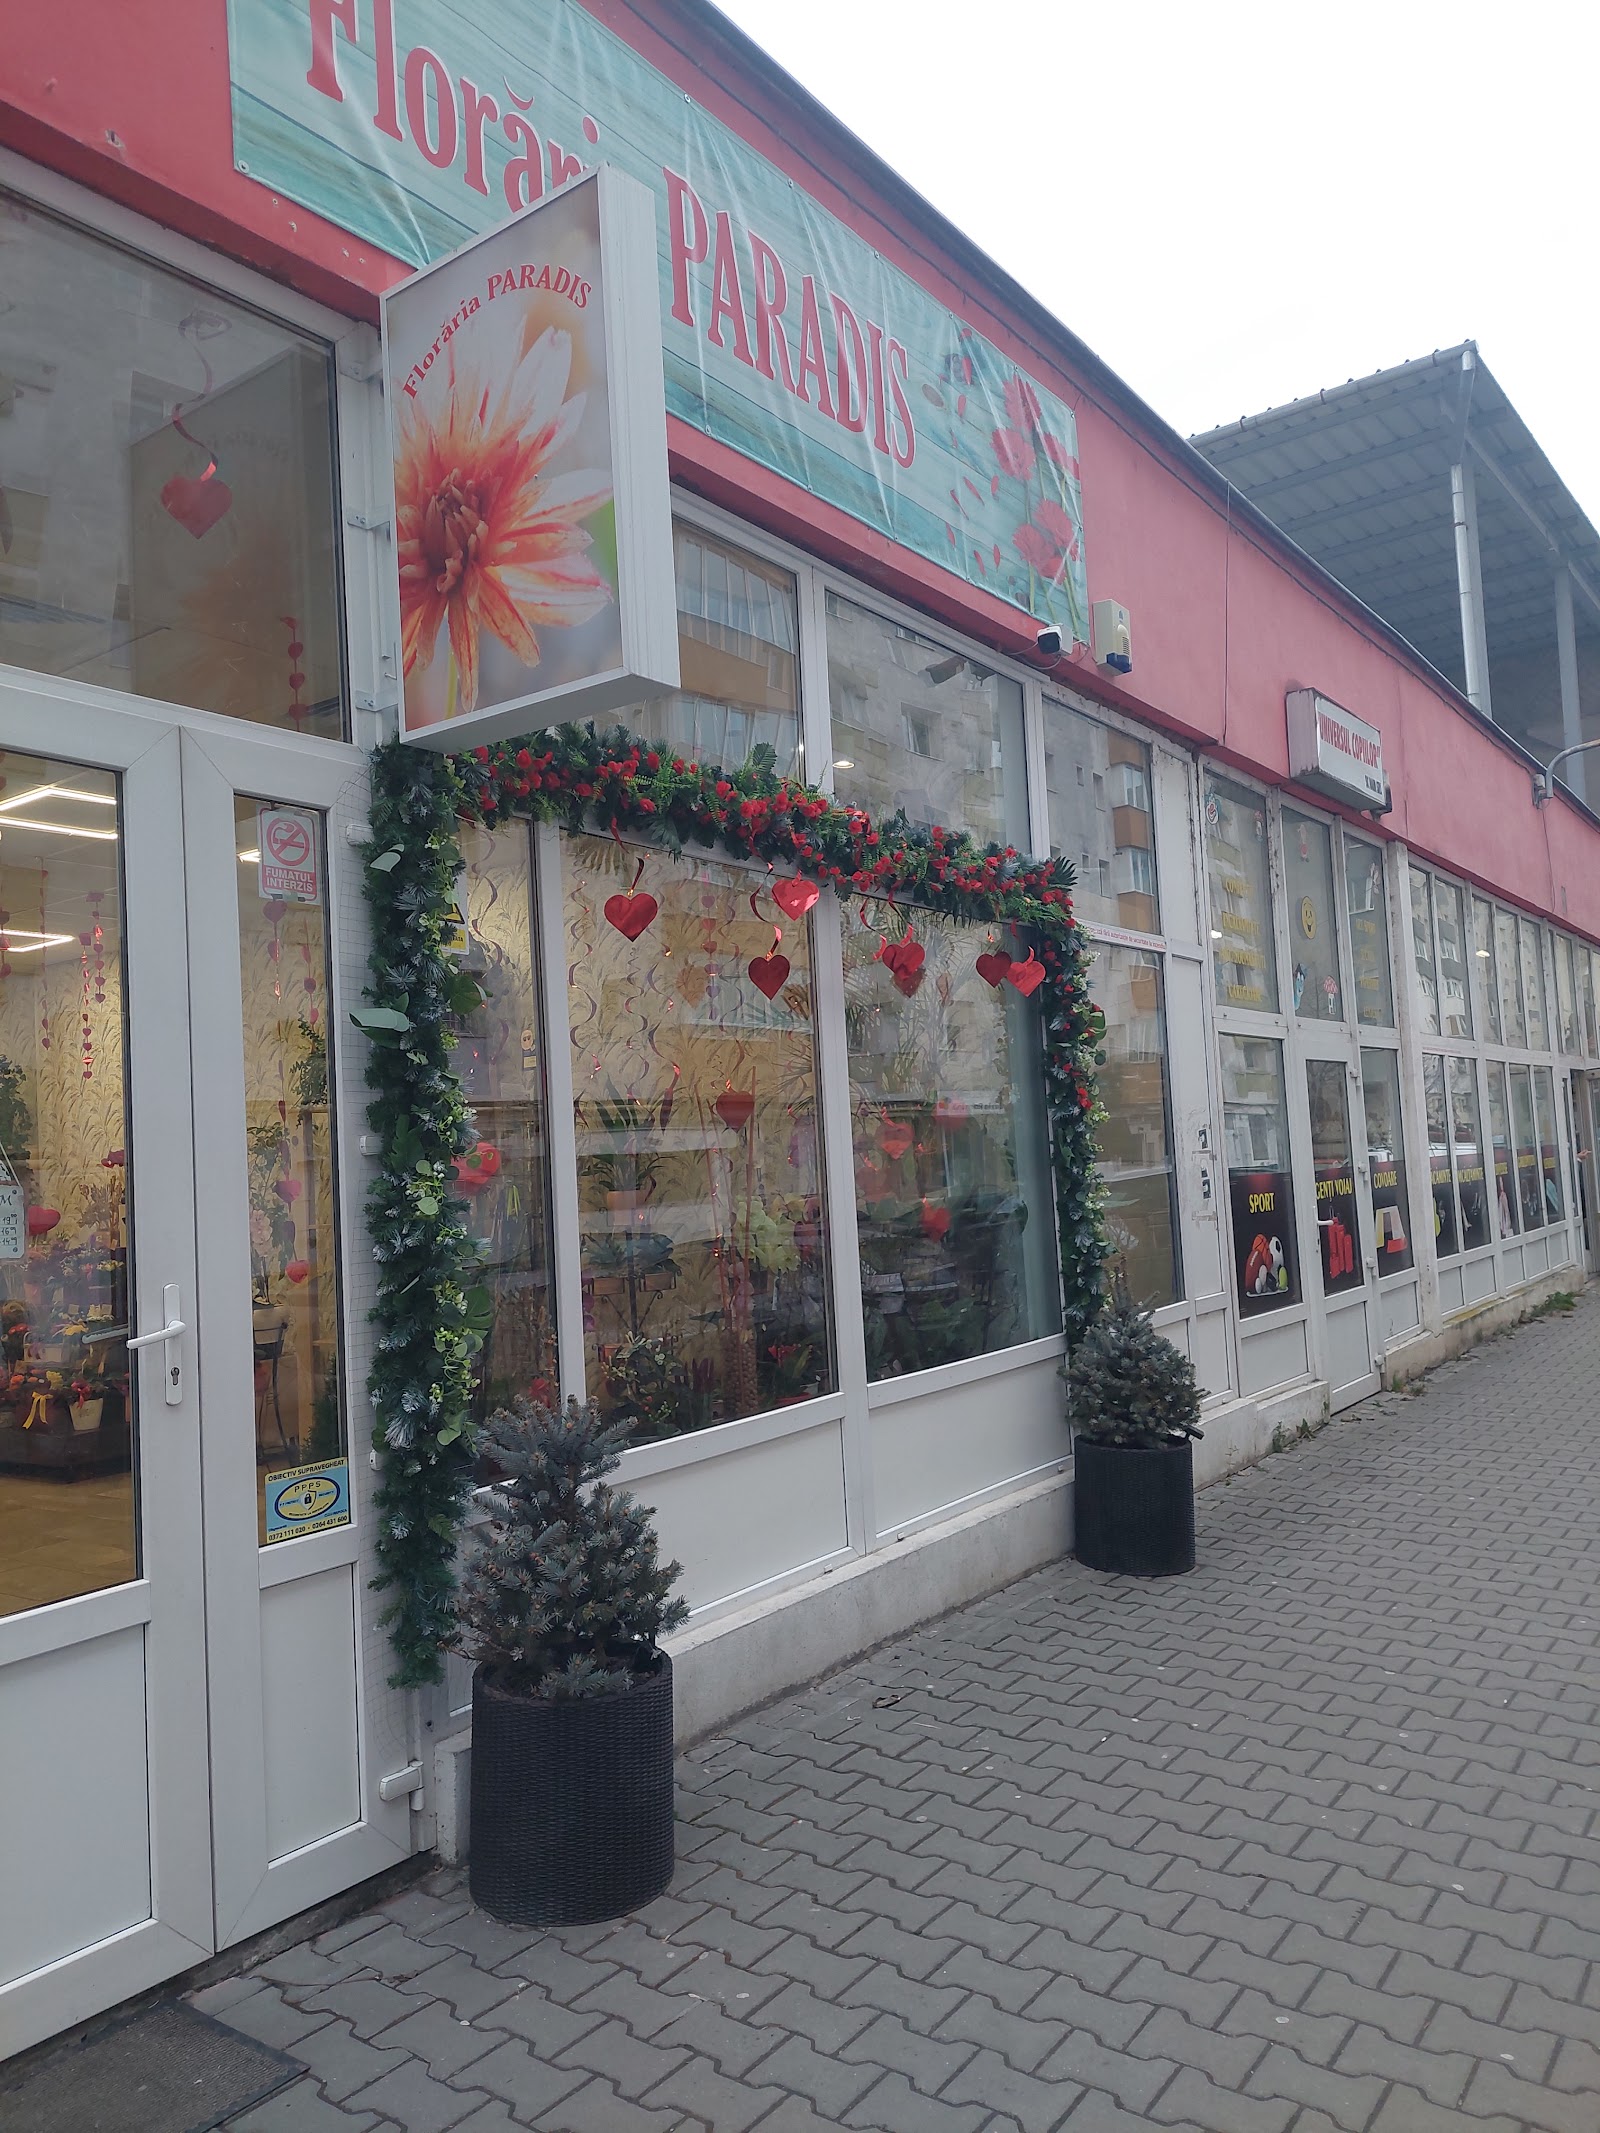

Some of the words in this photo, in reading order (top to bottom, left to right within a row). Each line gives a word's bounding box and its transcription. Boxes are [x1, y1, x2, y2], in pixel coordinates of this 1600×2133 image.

[662, 165, 917, 469] PARADIS
[403, 295, 481, 399] Florăria
[487, 264, 592, 309] PARADIS
[266, 867, 313, 883] FUMATUL
[267, 877, 313, 892] INTERZIS
[1335, 1177, 1353, 1197] VOIAJ
[1373, 1170, 1398, 1189] COVOARE
[1249, 1192, 1275, 1214] SPORT
[268, 1471, 297, 1482] OBIECTIV
[297, 1460, 345, 1475] SUPRAVEGHEAT
[268, 1533, 283, 1541] 0372
